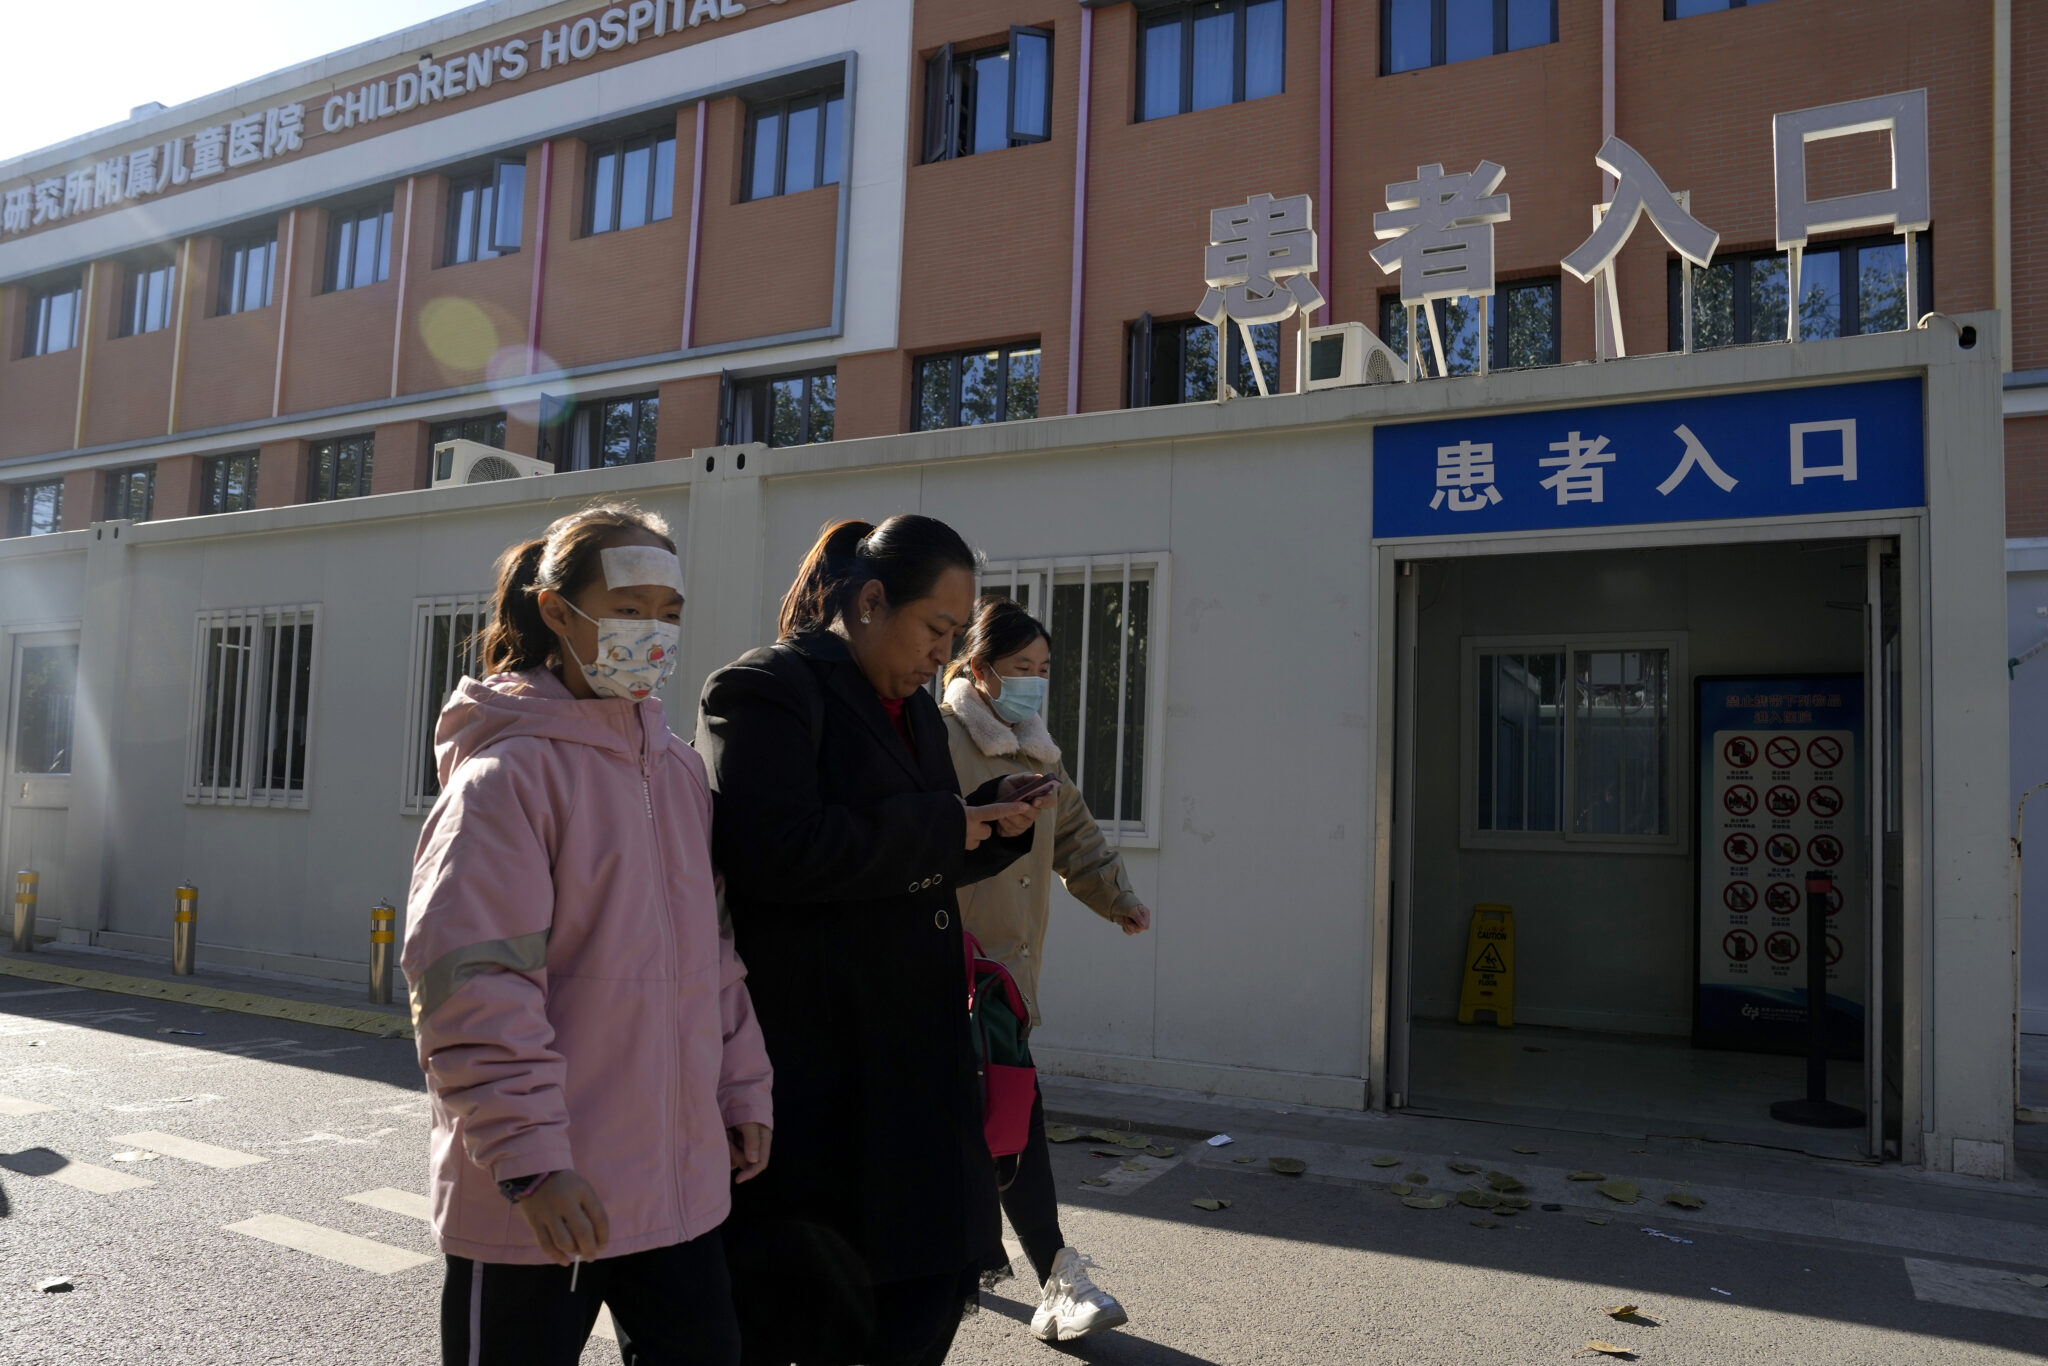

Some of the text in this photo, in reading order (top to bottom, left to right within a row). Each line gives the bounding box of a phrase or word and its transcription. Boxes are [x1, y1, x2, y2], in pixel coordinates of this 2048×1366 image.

[322, 39, 528, 134] CHILDREN'S
[1195, 87, 1930, 325] 患者入口
[1429, 417, 1859, 512] 患者入口
[1477, 932, 1506, 940] CAUTION
